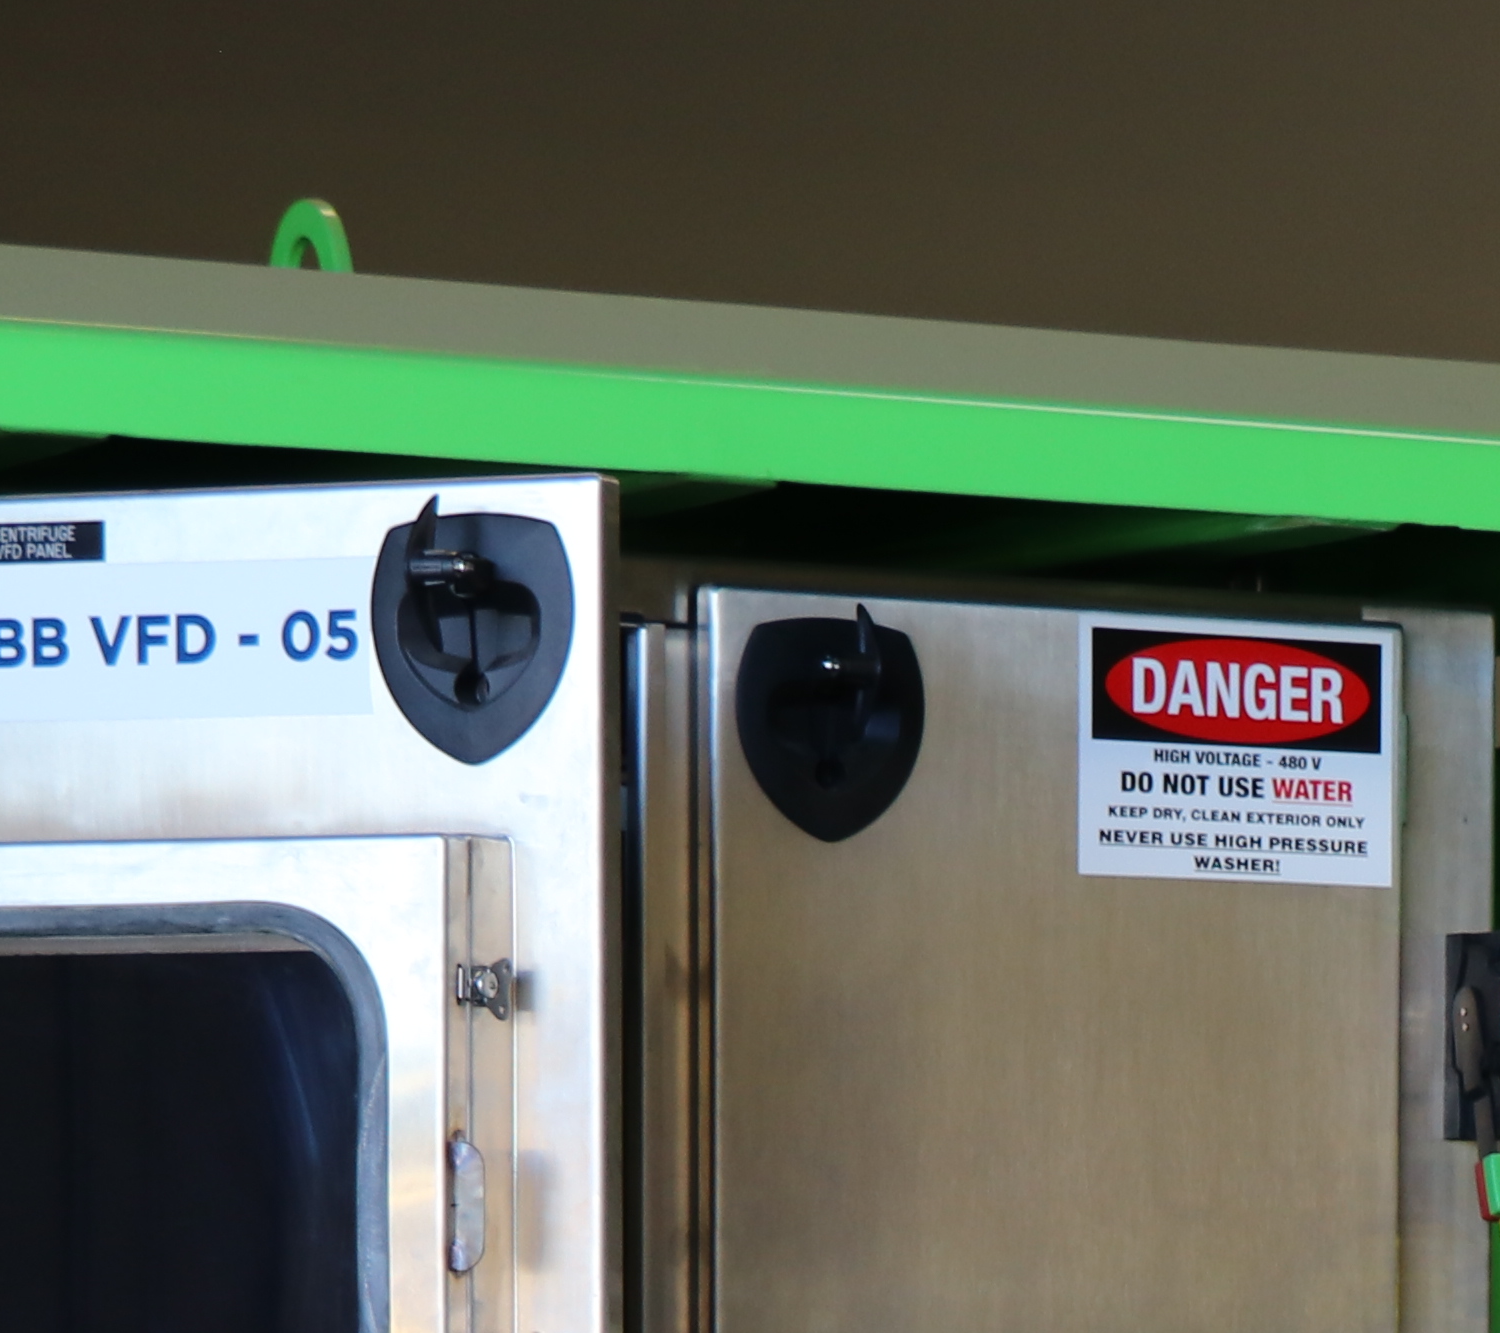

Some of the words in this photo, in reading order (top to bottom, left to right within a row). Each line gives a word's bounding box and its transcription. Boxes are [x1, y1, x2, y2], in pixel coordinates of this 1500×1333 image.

[26, 543, 73, 559] PANEL
[90, 614, 217, 666] VFD
[238, 634, 259, 646] -
[281, 609, 359, 661] 05
[1132, 657, 1343, 724] DANGER
[1154, 749, 1191, 764] HIGH
[1196, 751, 1262, 767] VOLTAGE
[1279, 756, 1306, 770] 480
[1310, 758, 1322, 771] V
[1121, 771, 1153, 793] DO
[1163, 773, 1210, 796] NOT
[1219, 776, 1265, 798] USE
[1271, 778, 1353, 803] WATER
[1108, 806, 1148, 818] KEEP
[1153, 808, 1186, 822] DRY,
[1191, 810, 1241, 823] CLEAN
[1247, 812, 1322, 827] EXTERIOR
[1326, 816, 1365, 829] ONLY
[1100, 829, 1163, 844] NEVER
[1170, 832, 1208, 847] USE
[1215, 835, 1262, 849] HIGH
[1269, 838, 1368, 855] PRESSURE
[1194, 856, 1281, 873] WASHER!
